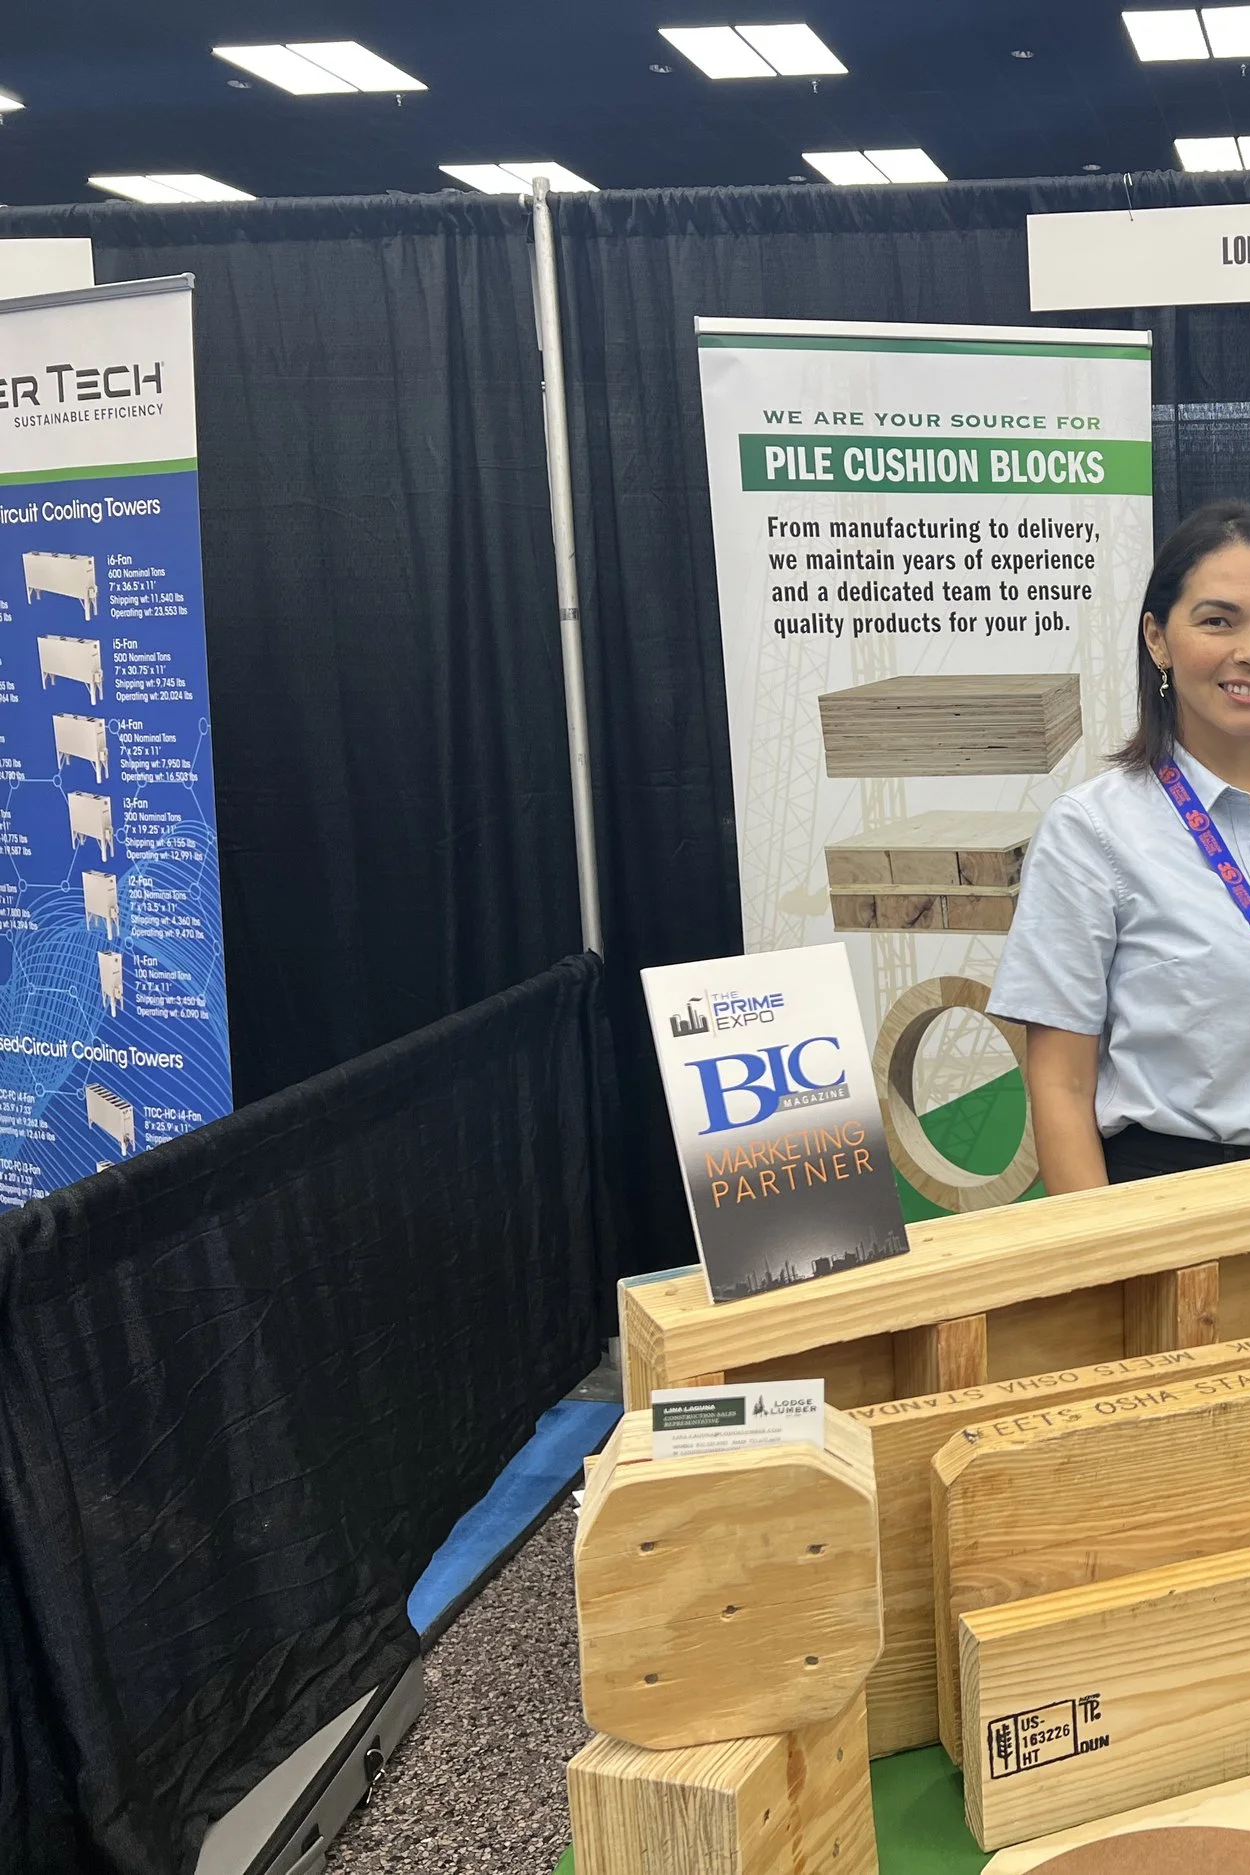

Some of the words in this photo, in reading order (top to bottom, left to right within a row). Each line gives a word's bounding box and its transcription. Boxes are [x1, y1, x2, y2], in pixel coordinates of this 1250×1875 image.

[46, 362, 163, 402] TECH
[14, 410, 90, 428] SUSTAINABLE
[94, 403, 164, 422] EFFICIENCY
[763, 410, 803, 425] WE
[814, 411, 864, 426] ARE
[874, 412, 941, 428] YOUR
[950, 414, 1047, 430] SOURCE
[1056, 416, 1101, 431] FOR
[765, 445, 834, 481] PILE
[843, 448, 979, 483] CUSHION
[990, 449, 1105, 484] BLOCKS
[42, 499, 102, 523] Cooling
[104, 497, 160, 517] Towers
[767, 516, 820, 538] From
[830, 518, 981, 543] manufacturing
[988, 519, 1009, 538] to
[1017, 518, 1100, 542] delivery,
[107, 554, 132, 565] i6-Fan
[769, 553, 797, 570] we
[805, 550, 895, 571] maintain
[903, 553, 956, 575] years
[964, 549, 983, 570] of
[991, 552, 1096, 574] experience
[108, 568, 122, 578] 600
[123, 568, 150, 577] Nominal
[151, 567, 165, 577] Tons
[110, 594, 139, 606] Shipping
[772, 581, 809, 602] and
[818, 585, 829, 602] a
[837, 581, 934, 602] dedicated
[942, 583, 992, 602] team
[999, 583, 1019, 601] to
[1027, 584, 1093, 601] ensure
[111, 607, 143, 619] Operating
[774, 613, 844, 639] quality
[852, 612, 942, 639] products
[949, 611, 977, 632] for
[984, 615, 1027, 636] your
[1035, 610, 1070, 637] job.
[113, 638, 138, 649] i5-Fan
[113, 653, 127, 662] 500
[129, 652, 156, 662] Nominal
[157, 652, 171, 661] Tons
[712, 990, 740, 1001] THE
[713, 992, 785, 1017] PRIME
[716, 1010, 775, 1031] EXPO
[72, 1041, 127, 1068] Cooling
[129, 1047, 183, 1068] Towers
[684, 1036, 846, 1136] BIC
[783, 1088, 845, 1108] MAGAZINE
[705, 1120, 866, 1179] MARKETING
[711, 1148, 874, 1208] PARTNER
[996, 1371, 1079, 1395] OSHA
[770, 1405, 817, 1415] LUMBER
[774, 1398, 814, 1408] LODGE
[1094, 1389, 1179, 1416] OSHA
[1021, 1715, 1045, 1731] US-
[1022, 1724, 1070, 1748] 163226
[1080, 1734, 1109, 1753] DUN
[1022, 1748, 1040, 1766] HT
